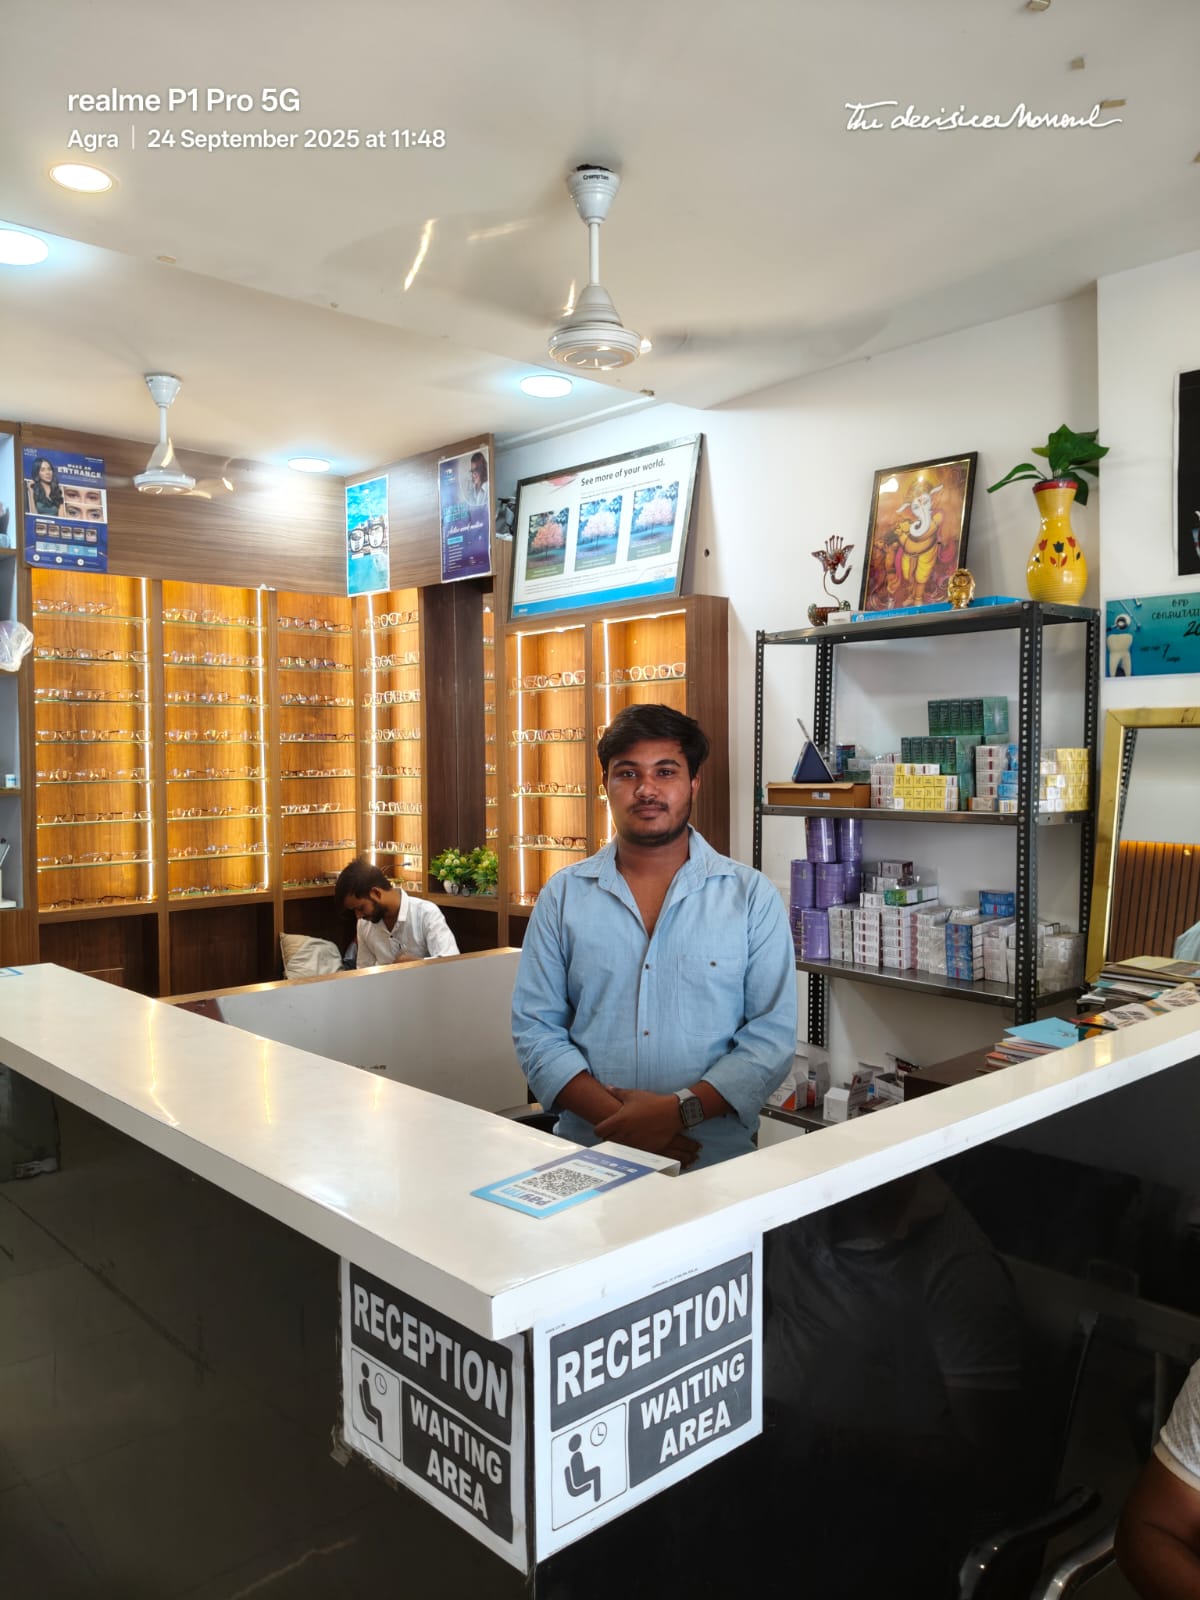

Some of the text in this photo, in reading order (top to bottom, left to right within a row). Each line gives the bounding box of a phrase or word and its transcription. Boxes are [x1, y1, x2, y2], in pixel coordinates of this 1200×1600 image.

[57, 466, 102, 479] ENTRANCE
[580, 457, 666, 486] See more of your world.
[353, 1283, 508, 1419] RECEPTION
[556, 1273, 749, 1407] RECEPTION
[640, 1352, 746, 1431] WAITING
[409, 1394, 503, 1485] WAITING
[659, 1399, 732, 1464] AREA
[426, 1448, 489, 1521] AREA
